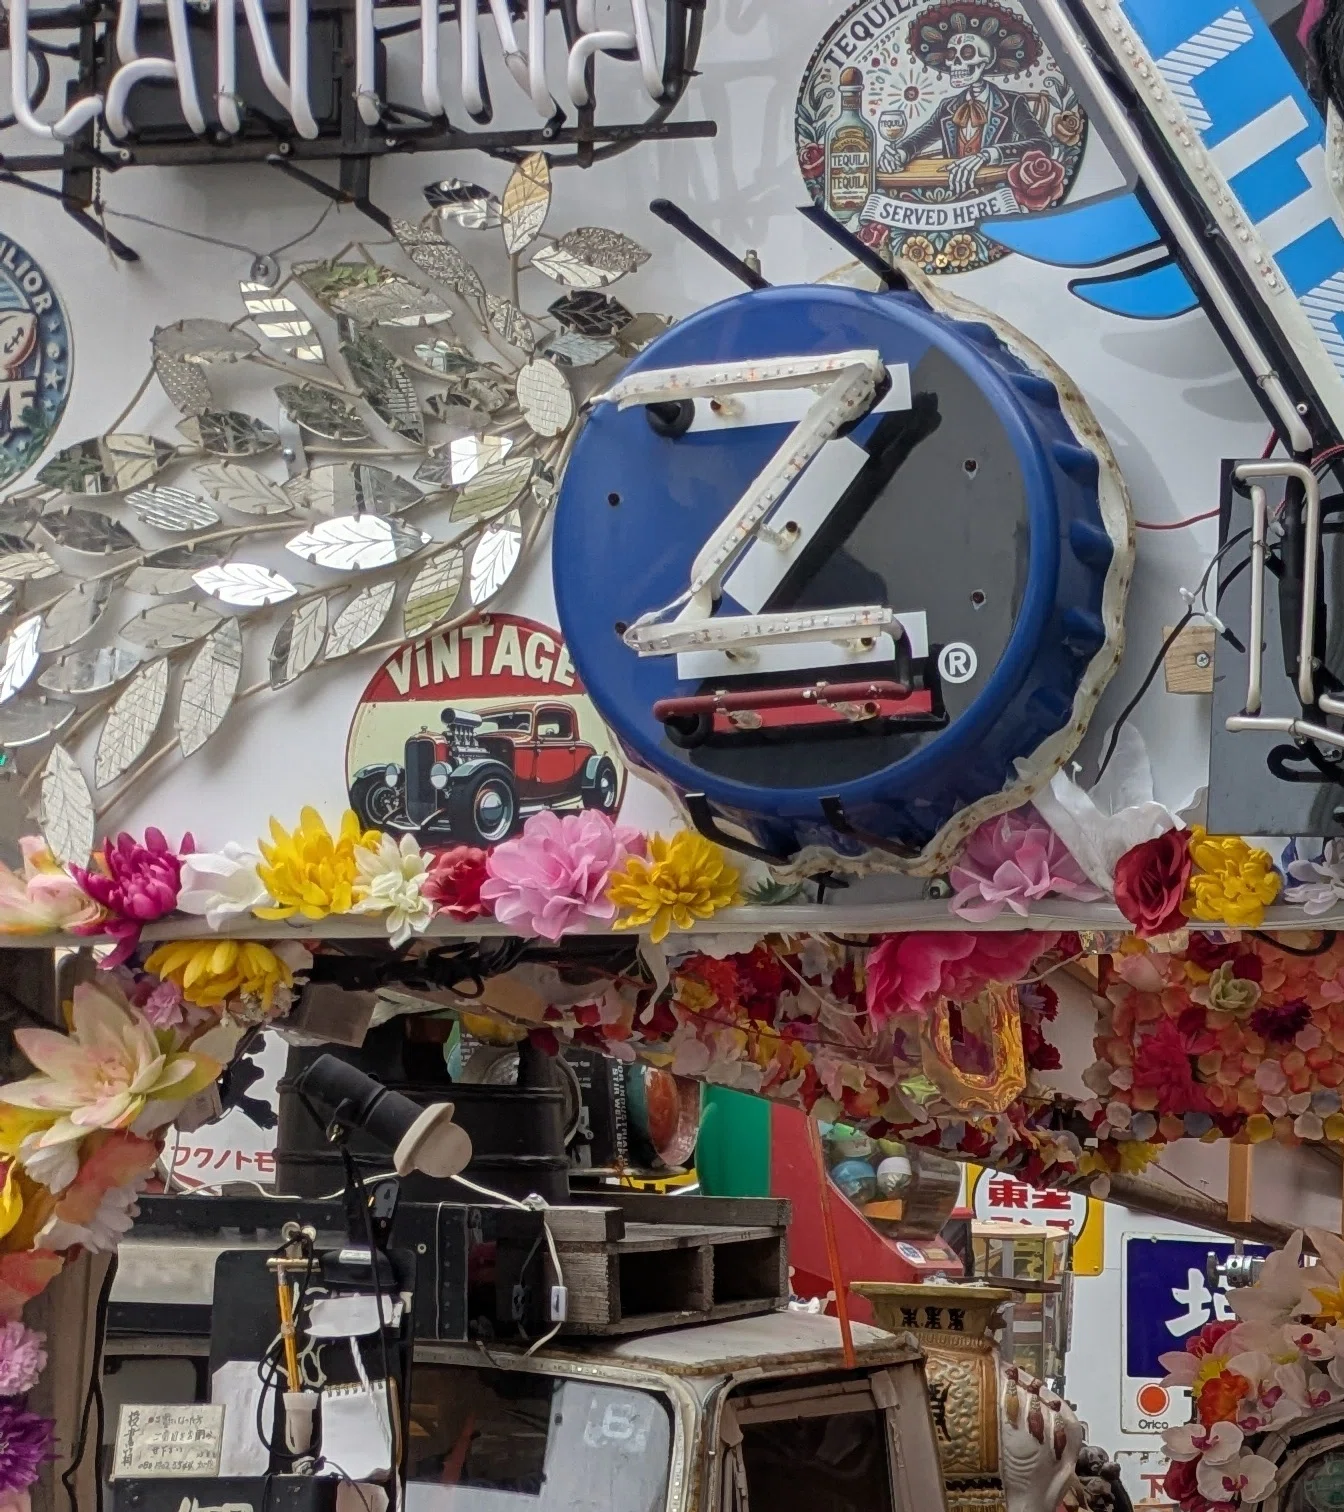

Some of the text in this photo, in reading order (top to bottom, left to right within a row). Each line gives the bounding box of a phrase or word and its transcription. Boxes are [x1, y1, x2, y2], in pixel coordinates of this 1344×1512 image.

[831, 154, 869, 168] TEQUILA
[831, 175, 869, 190] TEQUILA
[880, 196, 1001, 227] SERVED HERE
[1138, 1418, 1169, 1431] Orico
